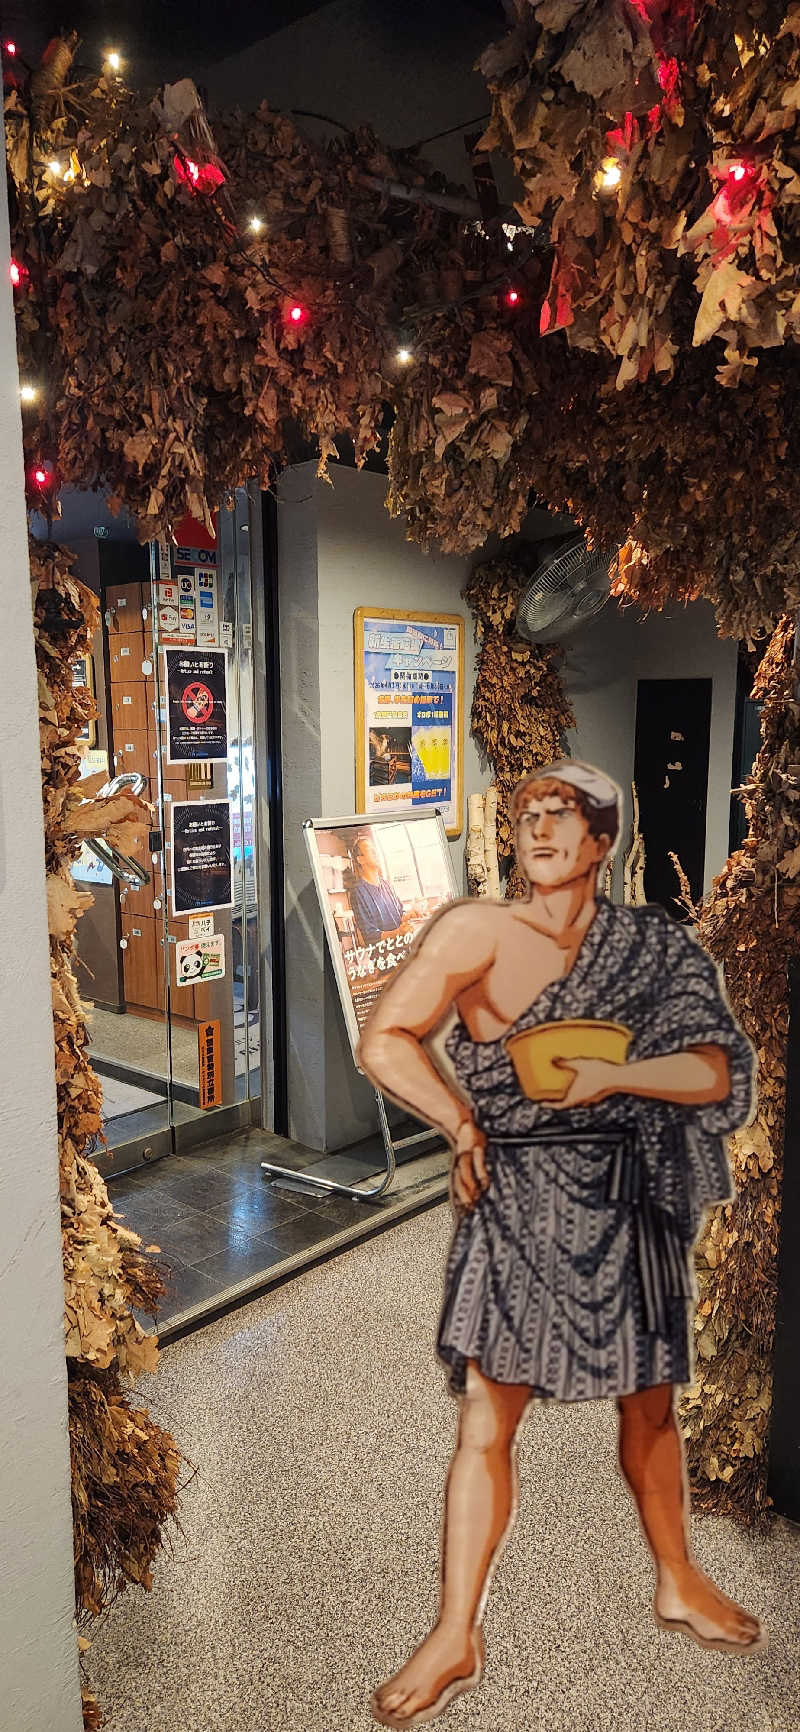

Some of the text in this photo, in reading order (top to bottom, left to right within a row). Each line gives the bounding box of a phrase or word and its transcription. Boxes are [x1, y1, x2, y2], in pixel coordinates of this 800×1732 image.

[177, 547, 217, 565] SEOM
[344, 928, 417, 964] サウナでととの
[348, 948, 412, 980] うなぎを食べ
